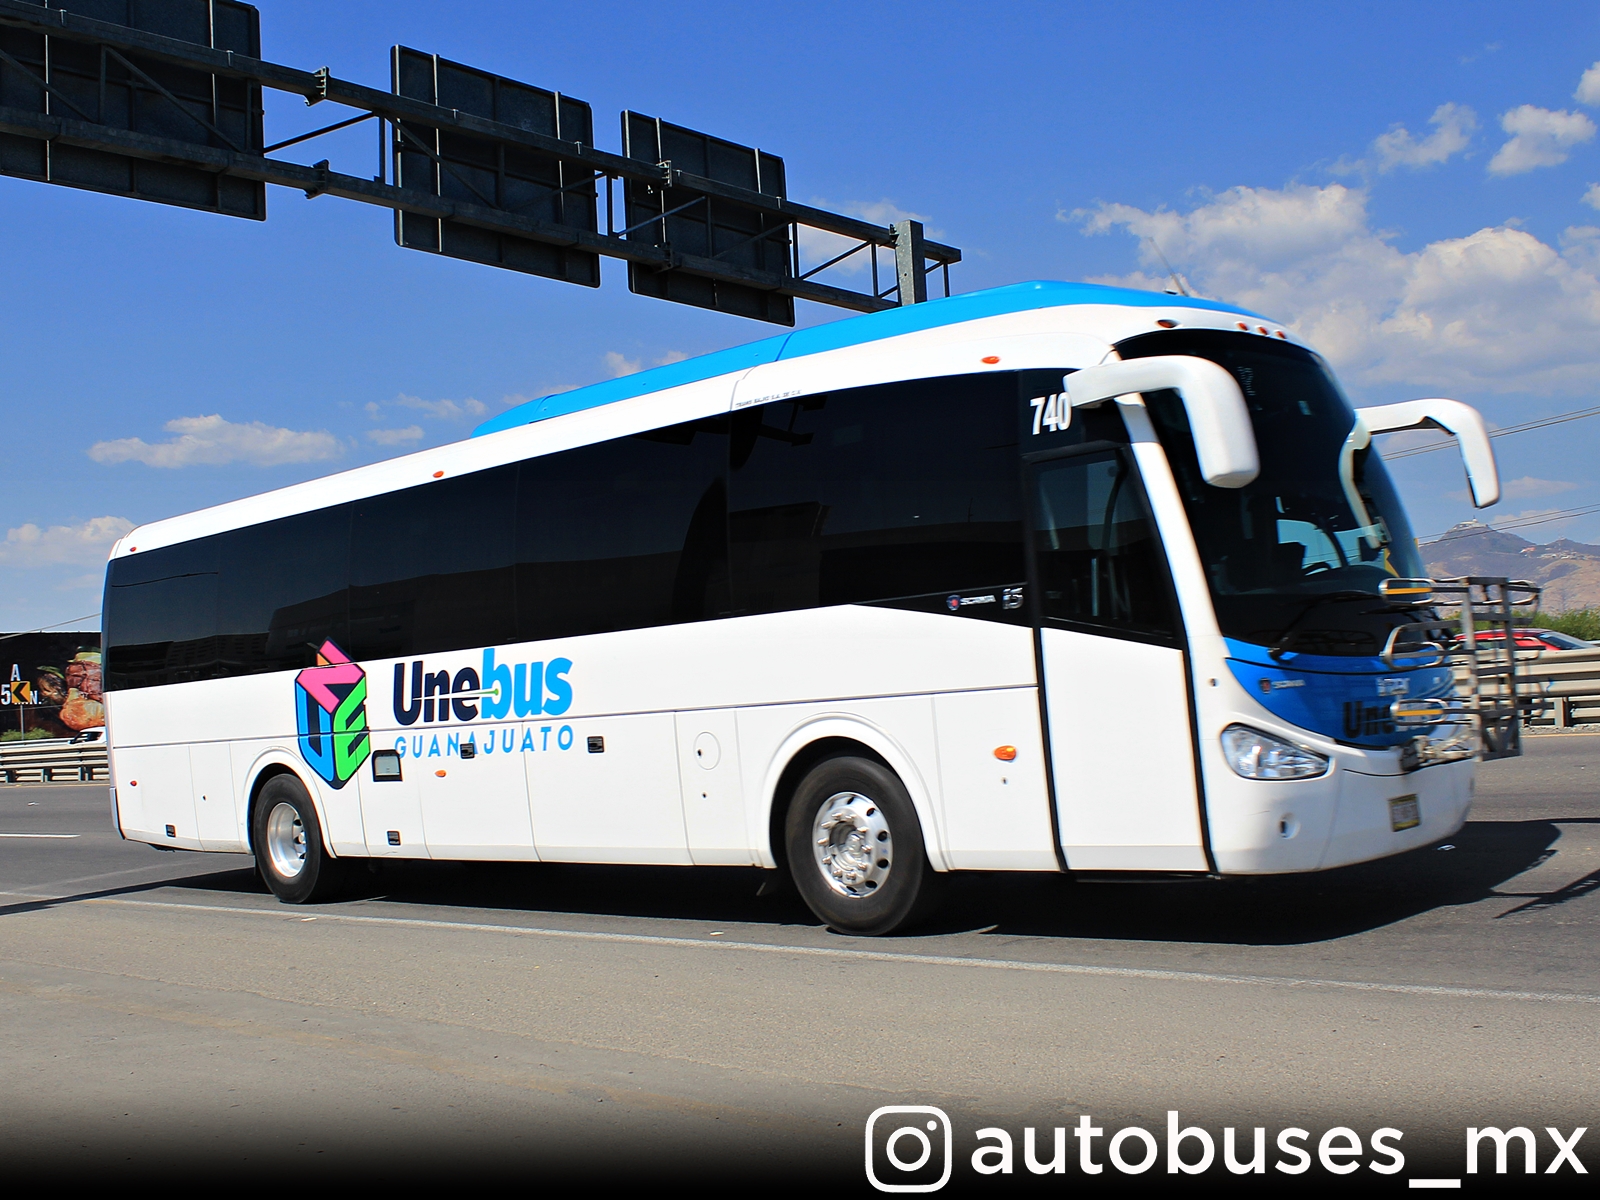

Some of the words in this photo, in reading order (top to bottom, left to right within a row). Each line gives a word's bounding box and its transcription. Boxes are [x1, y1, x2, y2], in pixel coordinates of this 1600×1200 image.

[1030, 392, 1072, 435] 740
[10, 663, 21, 682] A
[393, 648, 573, 726] Unebus
[0, 684, 11, 706] 5
[395, 725, 574, 759] GUANAJUATO
